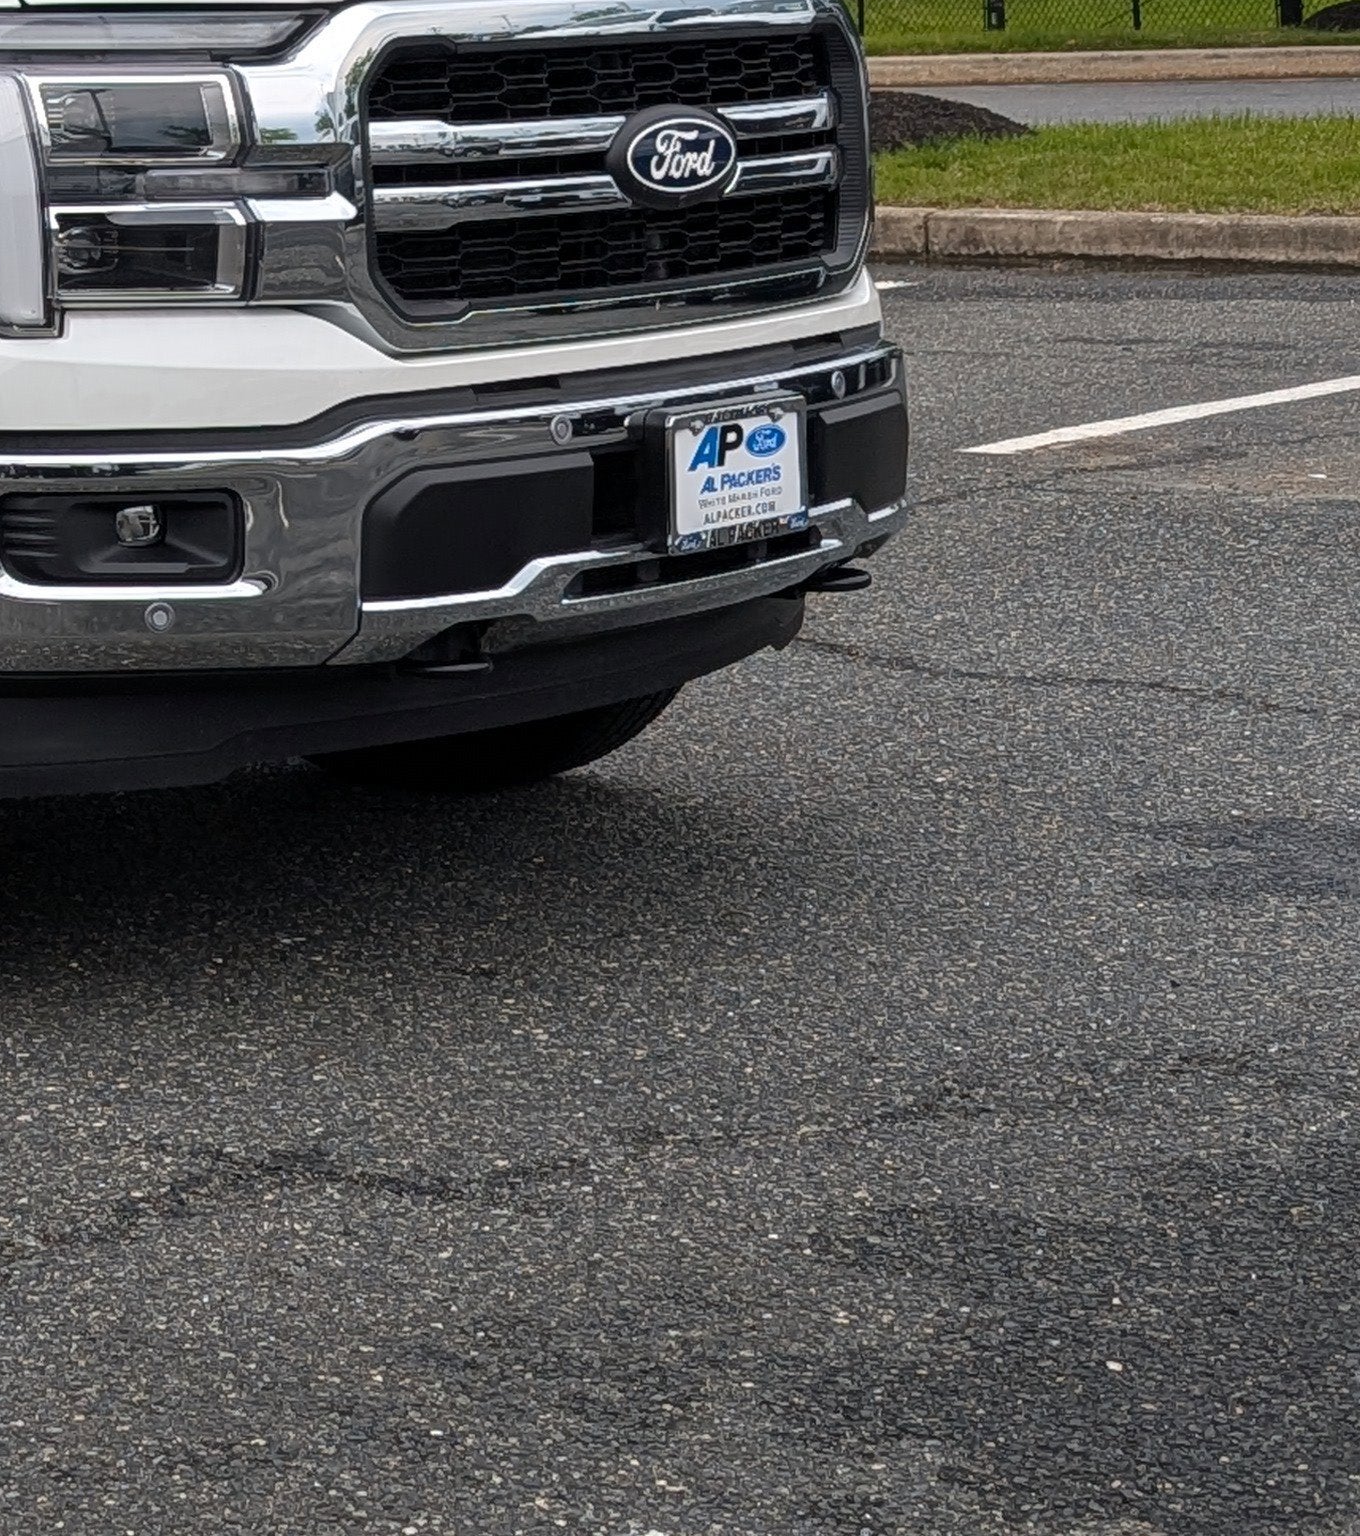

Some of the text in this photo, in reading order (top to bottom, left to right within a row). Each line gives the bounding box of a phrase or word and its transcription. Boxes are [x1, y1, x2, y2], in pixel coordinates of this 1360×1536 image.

[650, 129, 716, 180] Ford
[687, 423, 778, 472] AP Ford
[700, 476, 718, 495] AL
